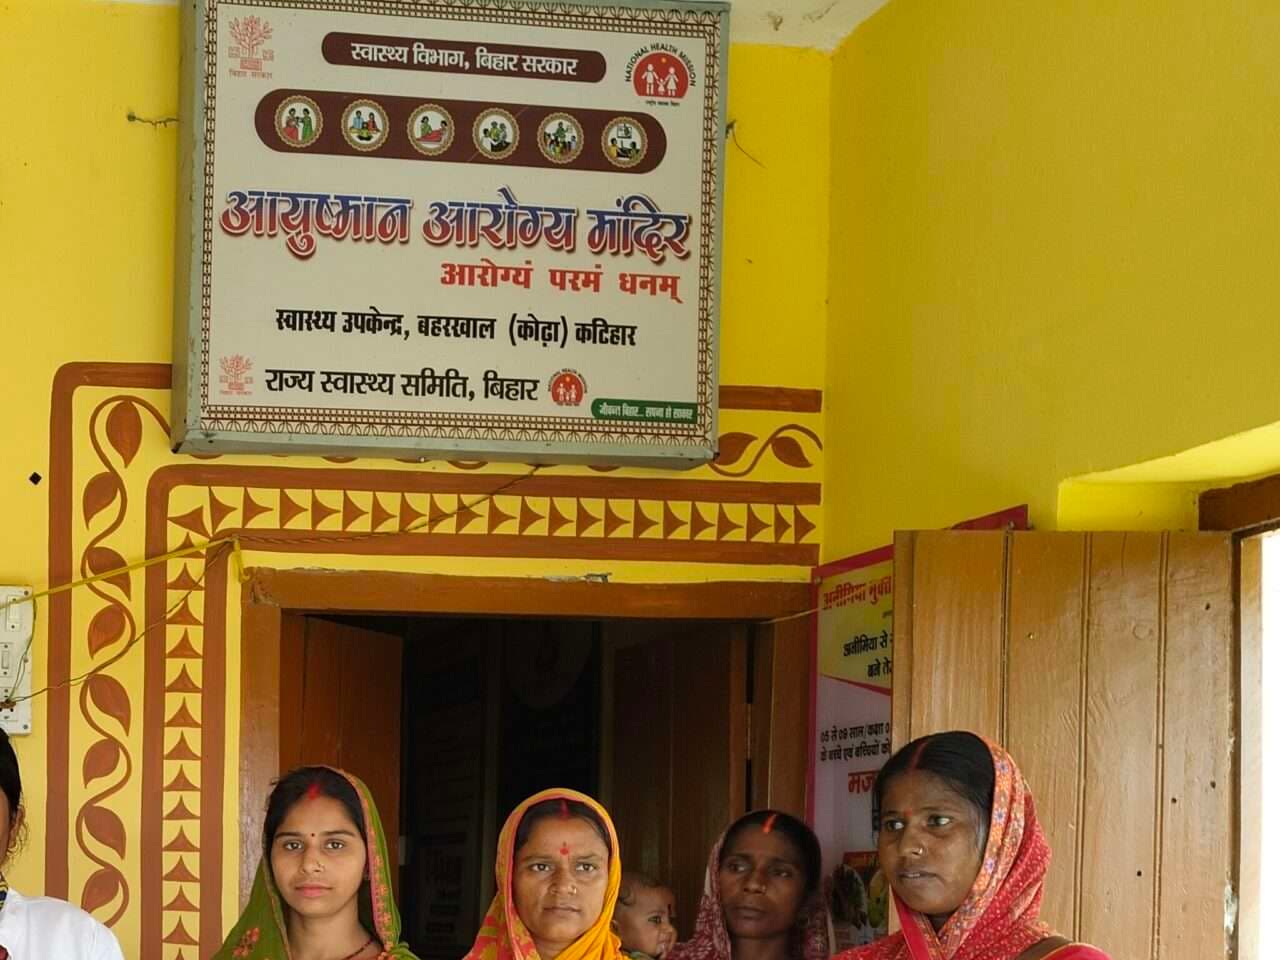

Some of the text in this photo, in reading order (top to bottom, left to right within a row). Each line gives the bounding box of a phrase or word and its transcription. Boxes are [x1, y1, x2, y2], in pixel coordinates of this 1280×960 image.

[351, 42, 579, 76] स्वास्थ्य विभाग, बिहार सरकार
[650, 42, 678, 54] HEALTH
[220, 184, 693, 264] आयुष्मान आरोग्य मंदिर
[440, 258, 684, 304] आरोग्यं परमं धनम्
[275, 309, 337, 333] स्वास्थ्य
[575, 318, 638, 346] कटिहार
[265, 369, 316, 393] राज्य
[320, 370, 396, 396] स्वास्थ्य
[401, 367, 476, 402] समिति,
[483, 370, 540, 401] बिहार
